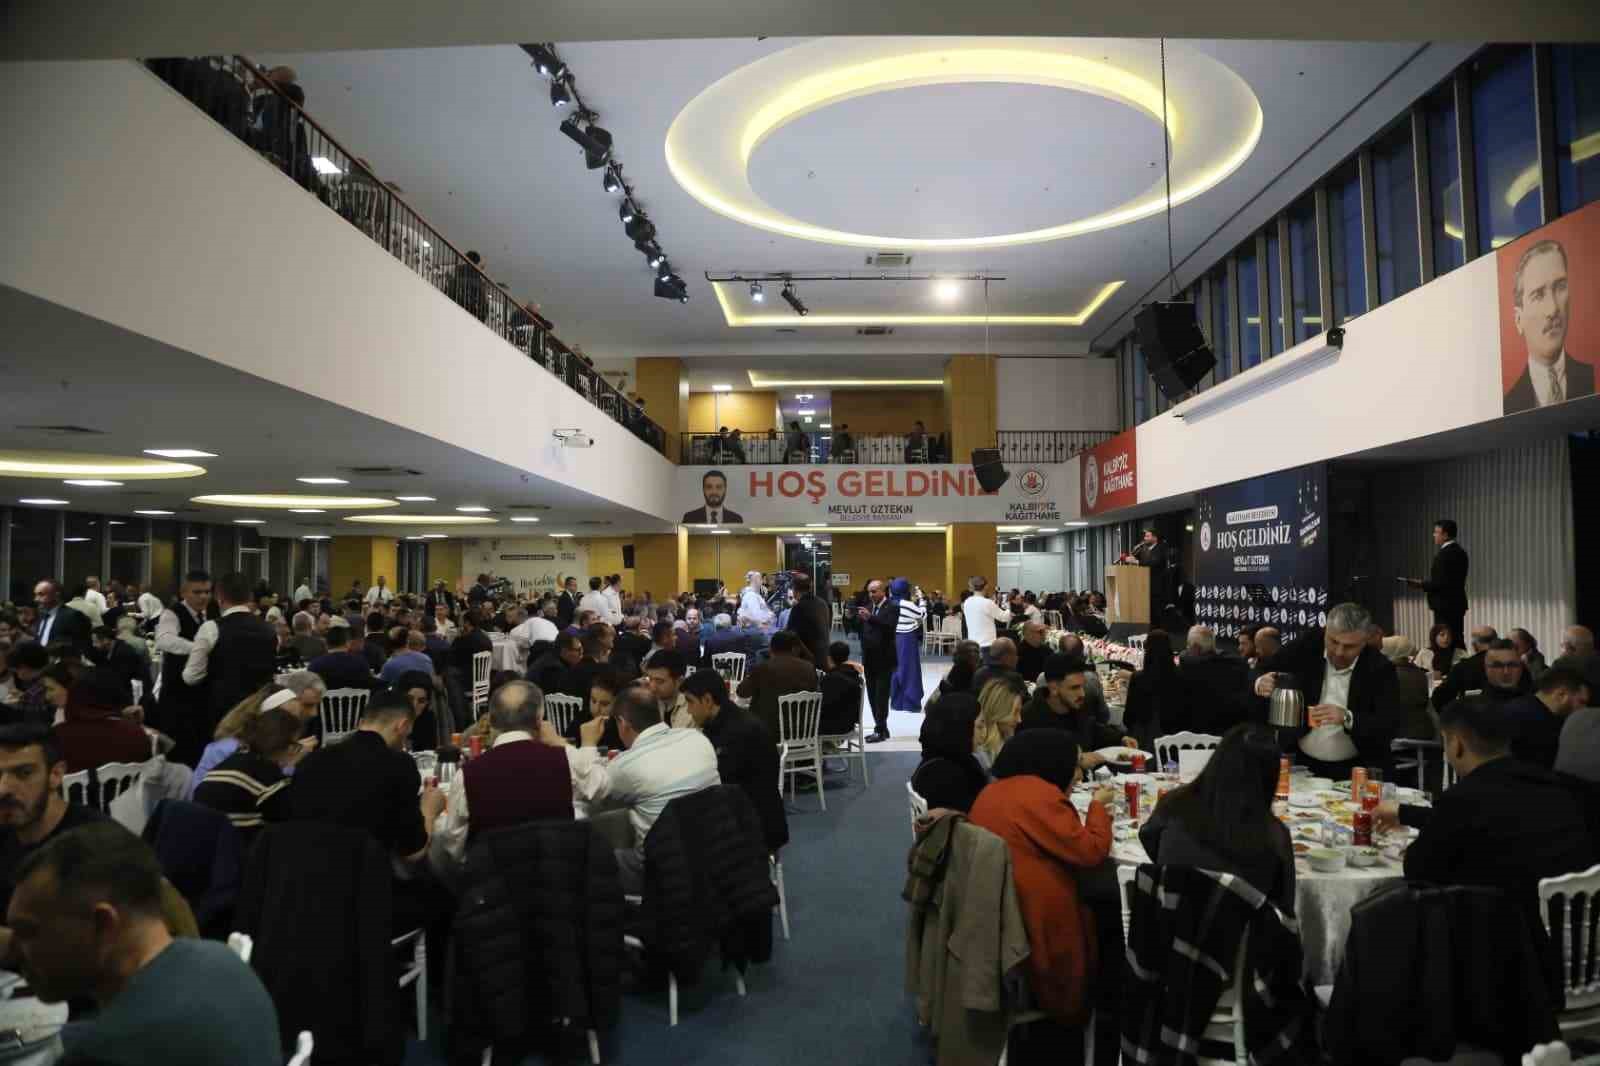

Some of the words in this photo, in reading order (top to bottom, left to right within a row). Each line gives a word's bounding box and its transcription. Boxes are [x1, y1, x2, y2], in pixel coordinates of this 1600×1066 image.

[749, 470, 828, 504] HOŞ
[1216, 530, 1237, 552] HOŞ
[1239, 521, 1291, 547] GELDİNİZ
